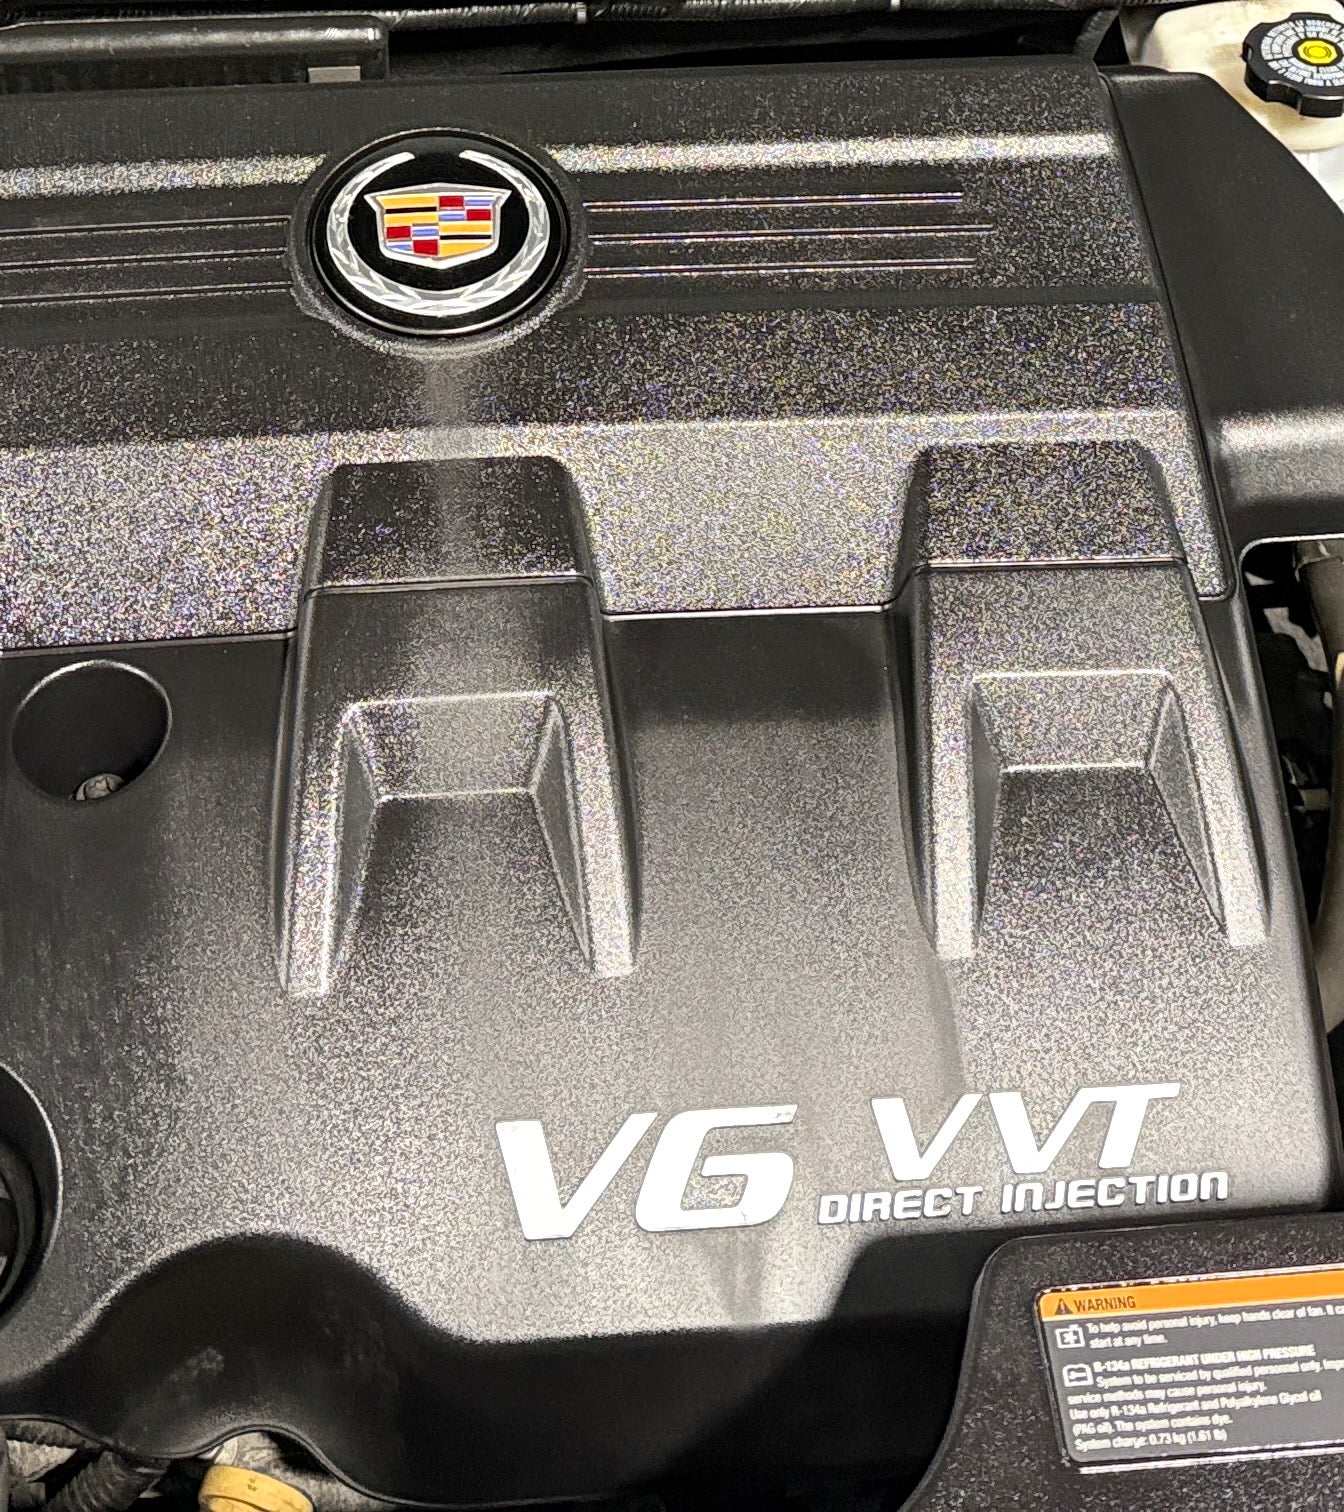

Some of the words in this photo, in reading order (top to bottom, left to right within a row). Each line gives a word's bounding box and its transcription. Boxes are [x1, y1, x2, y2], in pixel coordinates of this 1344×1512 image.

[493, 1103, 798, 1241] V6
[870, 1082, 1181, 1182] VVT
[816, 1185, 983, 1225] DIRECT
[1000, 1170, 1229, 1214] INJECTION
[1073, 1295, 1137, 1312] WARNING
